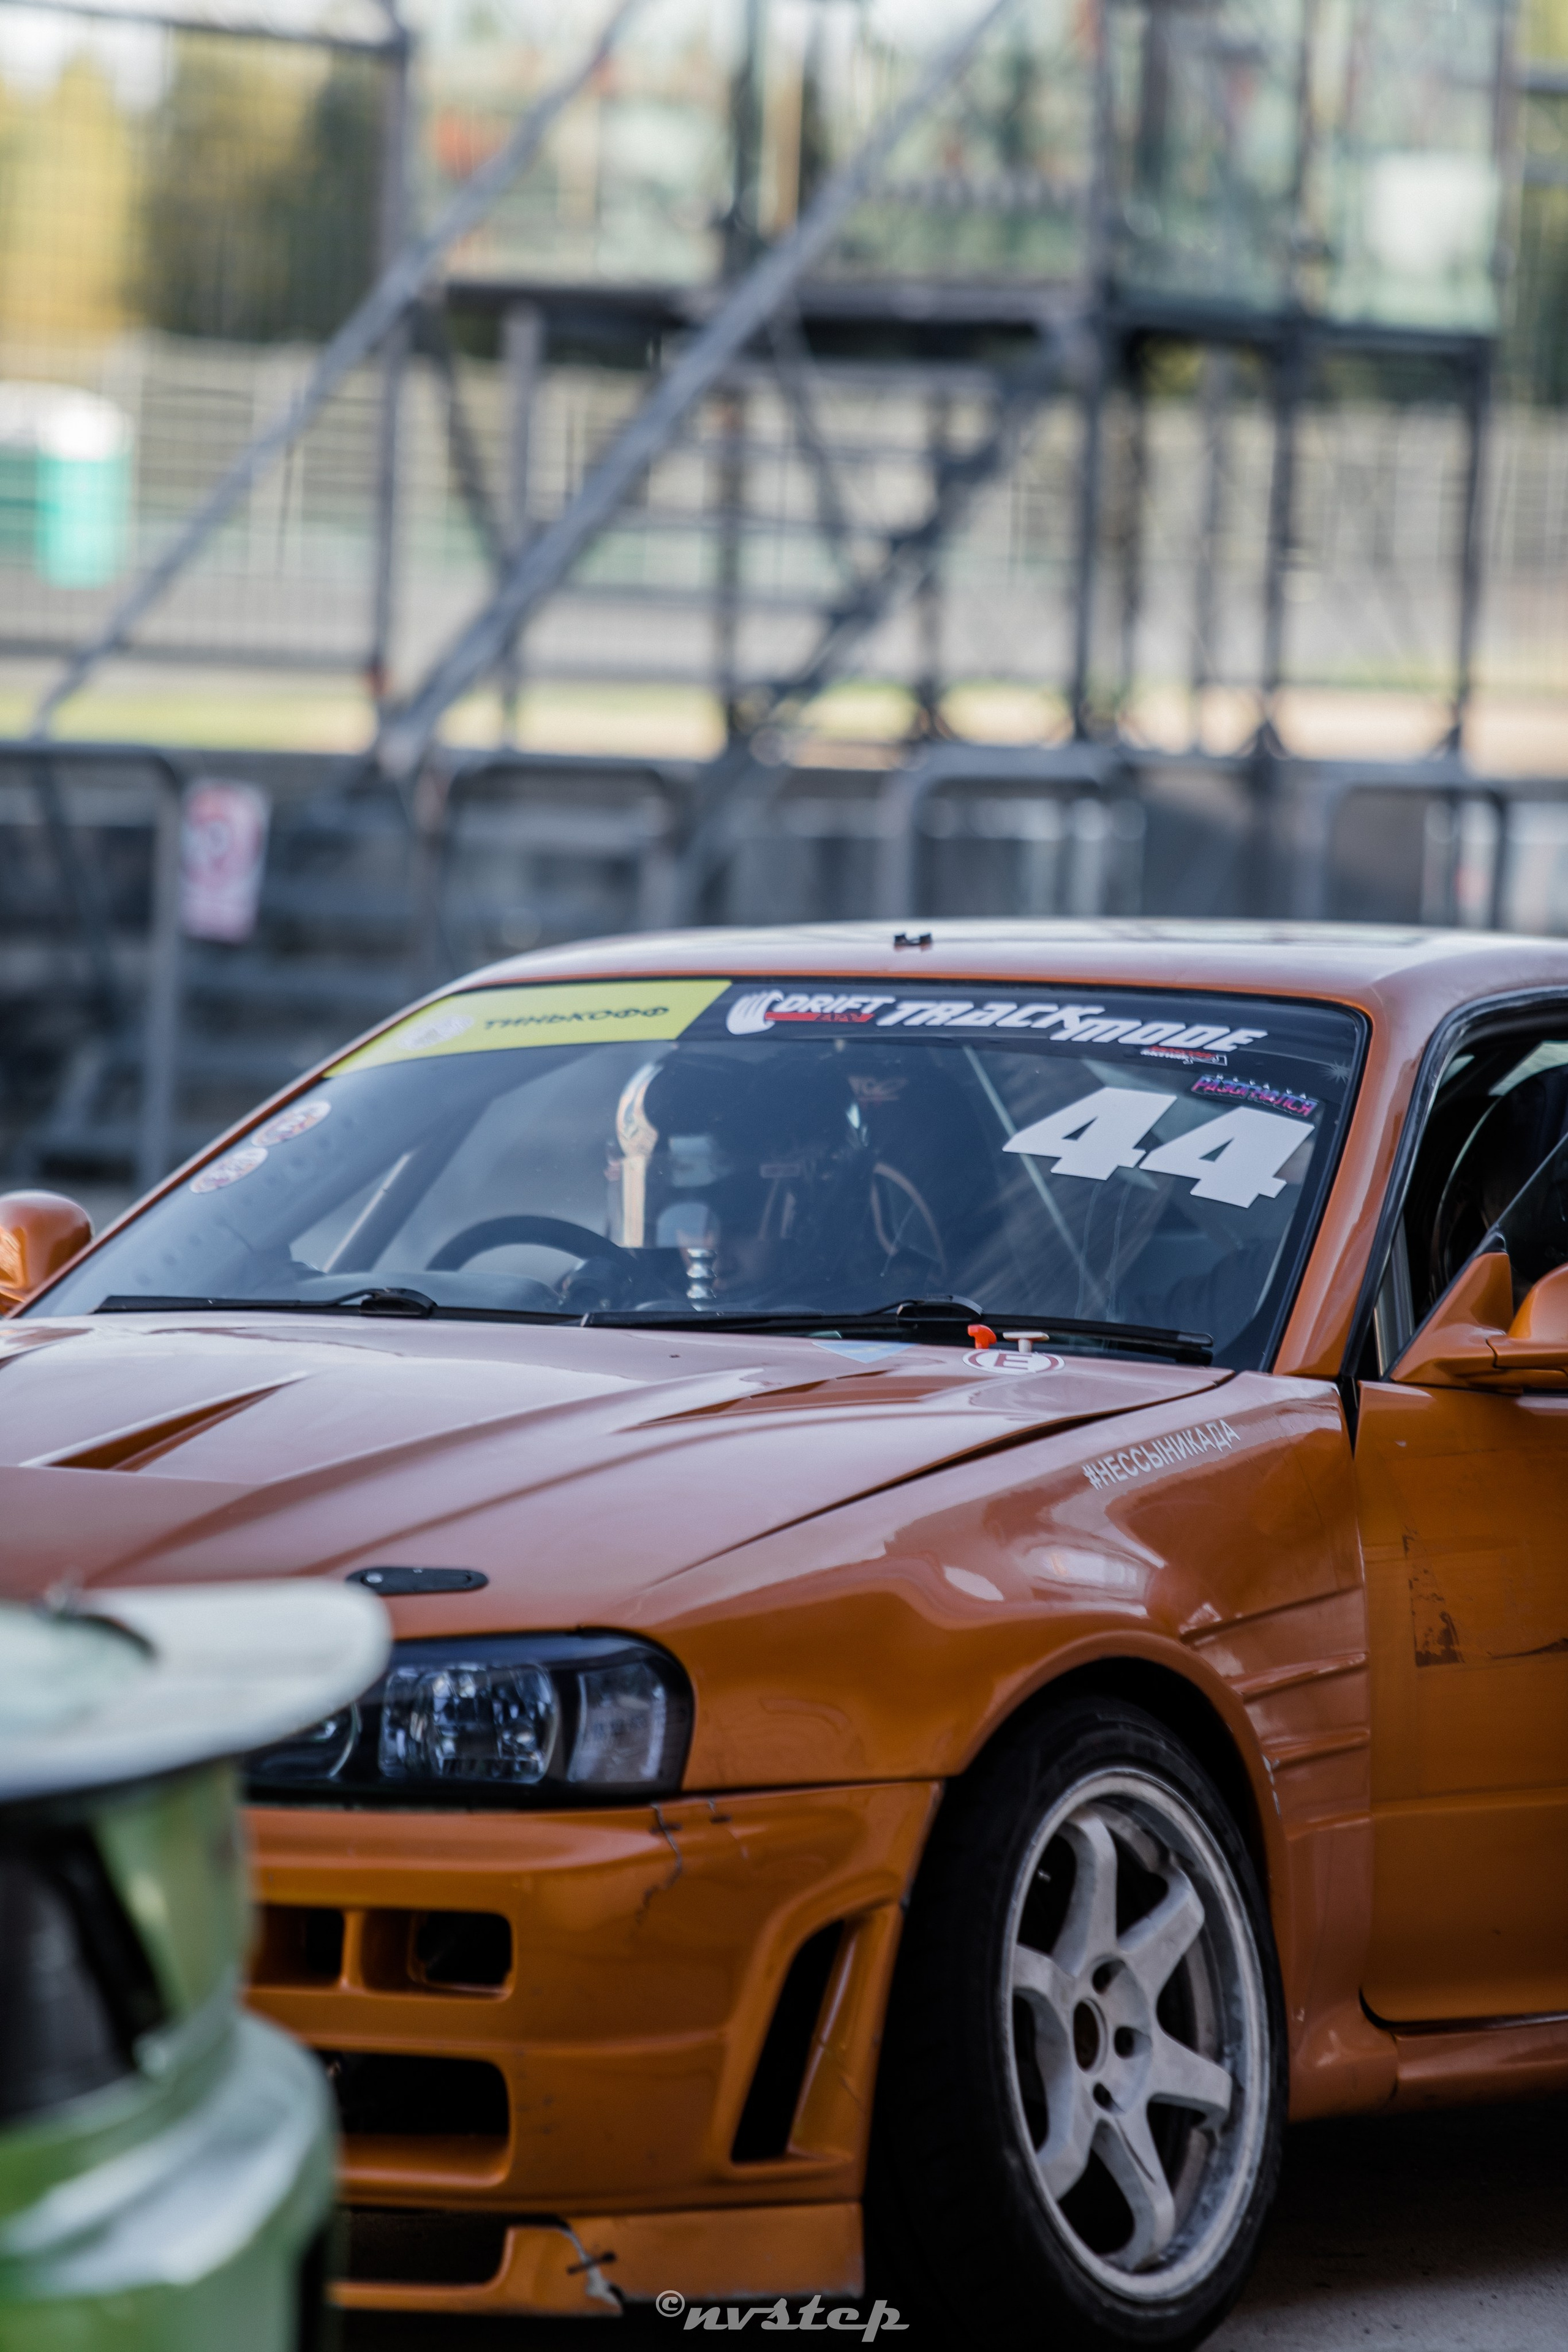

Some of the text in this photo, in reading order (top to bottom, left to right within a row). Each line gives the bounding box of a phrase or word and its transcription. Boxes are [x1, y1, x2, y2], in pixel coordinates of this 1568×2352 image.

[772, 993, 897, 1014] DRIFT
[1003, 1087, 1315, 1208] 44
[994, 1353, 1033, 1370] E
[1084, 1419, 1240, 1490] #НЕССЫНИКАДА
